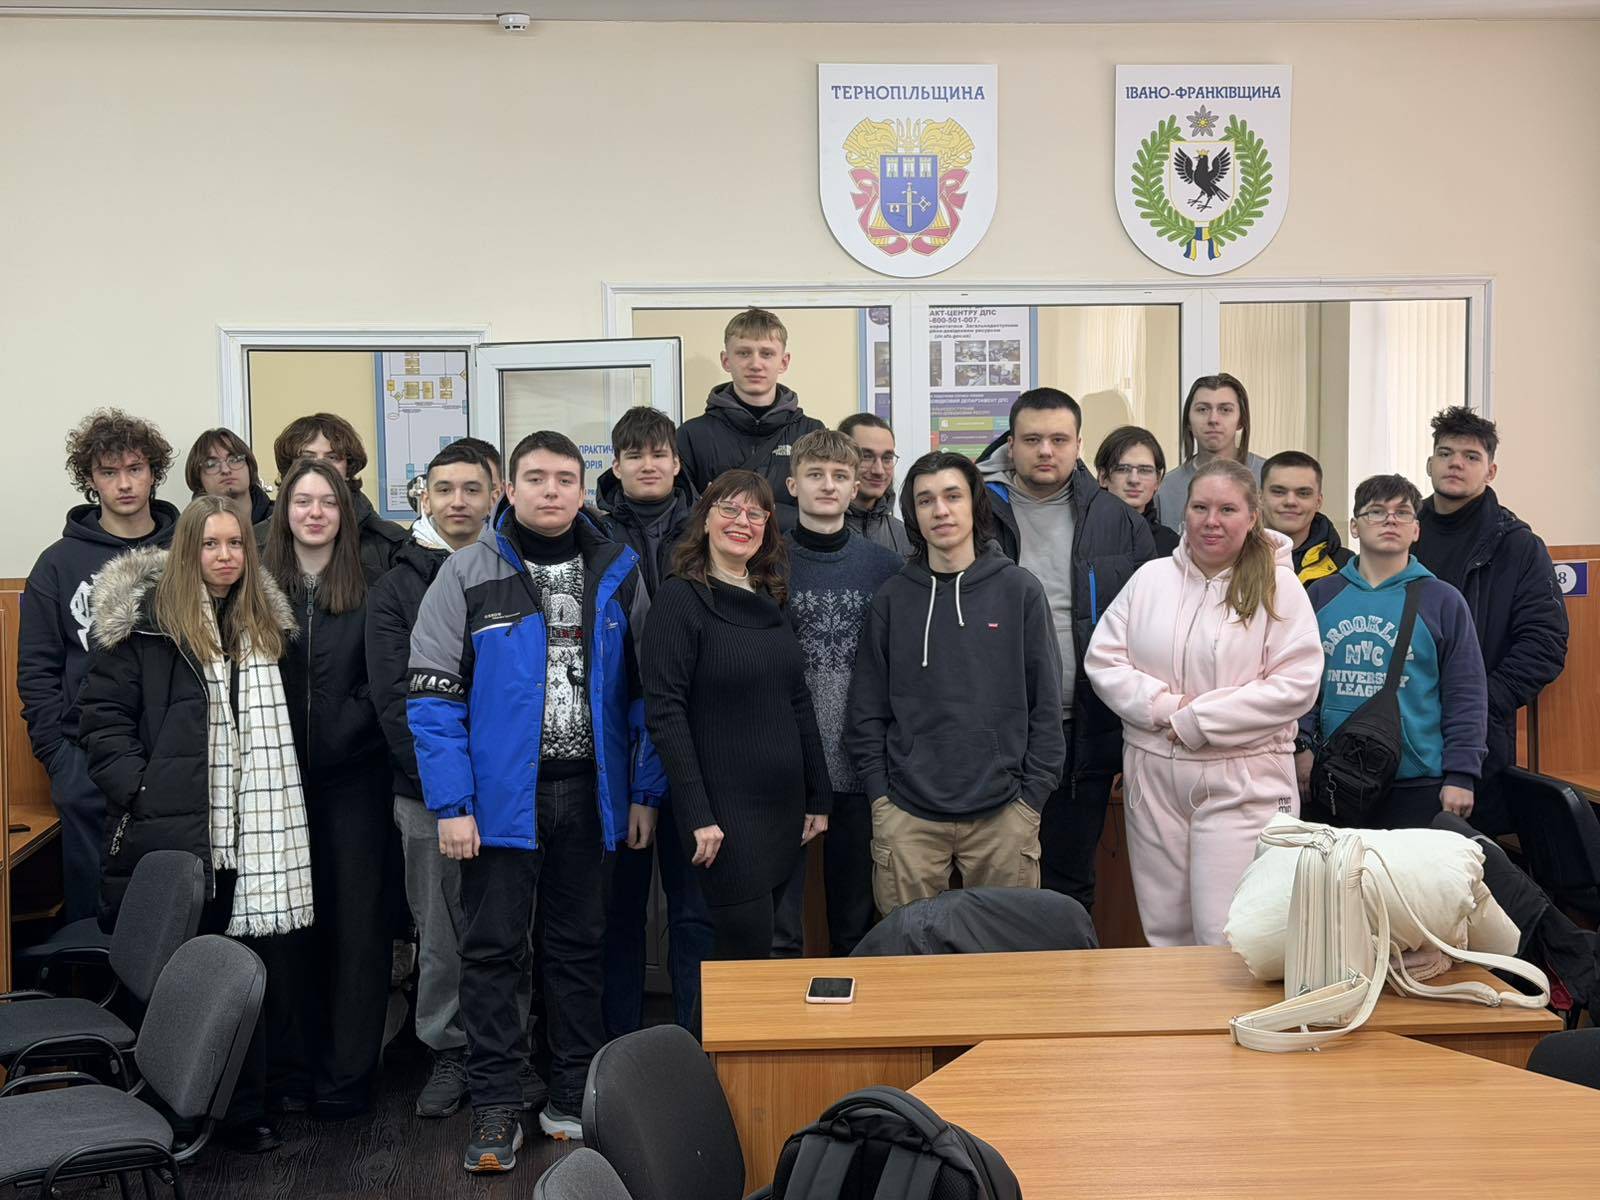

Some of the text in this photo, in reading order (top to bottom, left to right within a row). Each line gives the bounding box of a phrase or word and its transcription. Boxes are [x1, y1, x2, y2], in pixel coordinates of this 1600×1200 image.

[831, 85, 985, 102] ТЕРНОПІЛЬЩИНА
[1125, 86, 1281, 101] ІВАНО-ФРАНКІВЩИНА
[980, 309, 997, 317] ДПС
[1558, 571, 1567, 584] 8
[1322, 615, 1415, 660] BROOKL
[1345, 640, 1385, 667] NYC
